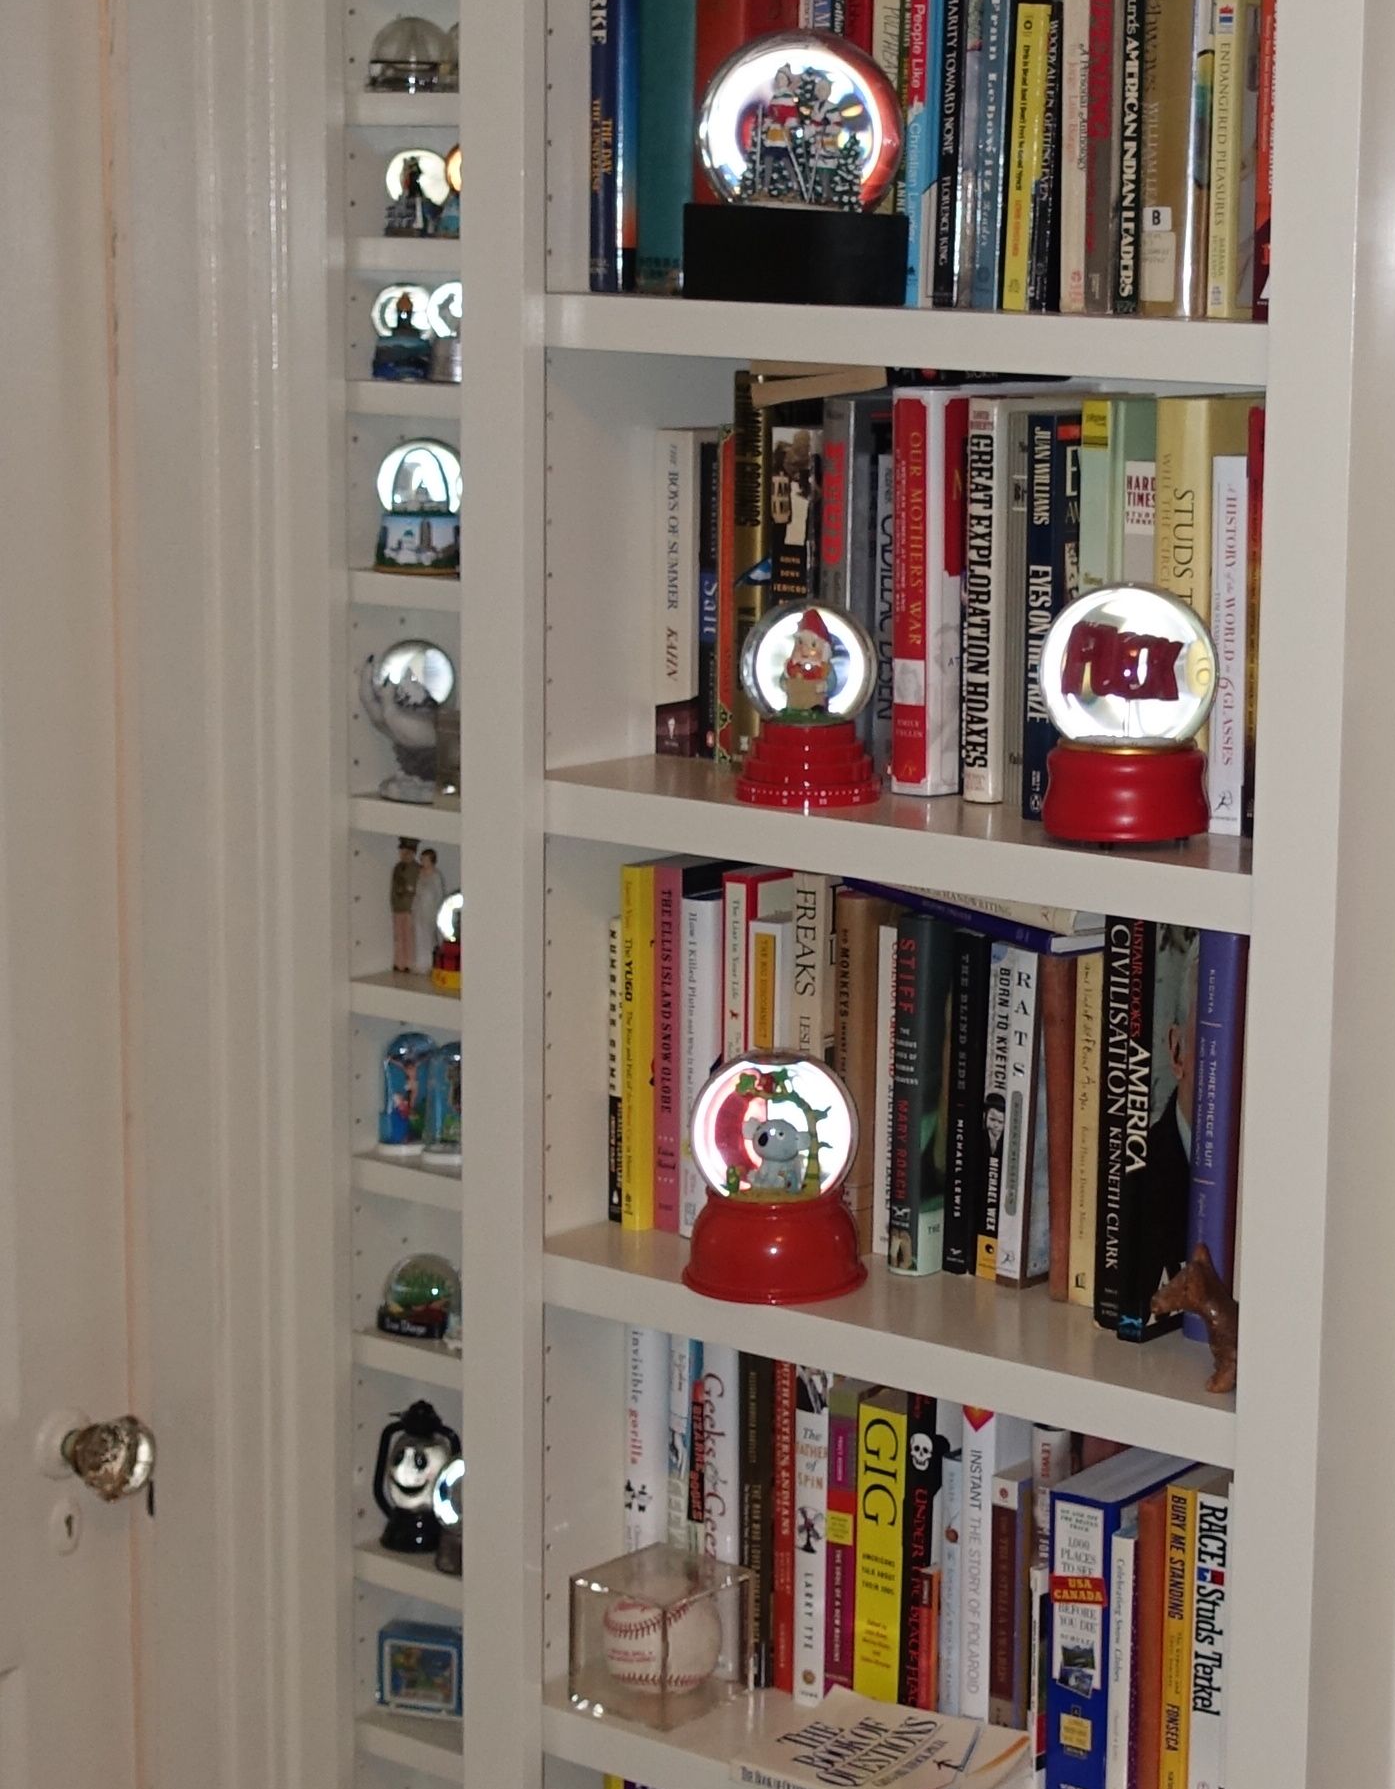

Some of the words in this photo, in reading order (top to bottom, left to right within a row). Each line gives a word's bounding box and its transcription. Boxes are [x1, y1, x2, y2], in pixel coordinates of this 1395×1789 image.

[911, 57, 924, 89] Like
[1126, 39, 1140, 131] AMERICAN
[1217, 42, 1231, 137] ENDANGERED
[1123, 130, 1139, 197] INDIAN
[1214, 142, 1230, 226] PLEASURES
[1120, 202, 1136, 298] LEADERS
[910, 431, 921, 471] OUR
[971, 434, 993, 510] GREAT
[667, 471, 680, 511] BOYS
[909, 481, 923, 592] MOTHERS'
[1173, 488, 1194, 578] STUDS
[667, 541, 679, 609] SUMMER
[703, 579, 718, 635] Salt
[966, 513, 993, 676] EXPLORATION
[908, 599, 921, 644] WAR
[665, 629, 679, 680] KAHN
[964, 683, 989, 768] HOAXES
[796, 888, 817, 997] FREAKS
[898, 938, 915, 1014] STIFF
[999, 967, 1011, 1011] BORN
[999, 1016, 1008, 1030] TO
[1107, 924, 1131, 1116] CIVILISATION
[995, 1033, 1008, 1094] KVETCH
[1125, 1038, 1152, 1173] AMERICA
[1107, 1125, 1122, 1203] KENNETH
[1103, 1212, 1119, 1270] CLARK
[863, 1418, 898, 1529] GIG
[968, 1449, 983, 1511] INSTANT
[968, 1517, 983, 1545] THE
[1172, 1534, 1184, 1553] ME
[1174, 1494, 1187, 1531] BURY
[1198, 1502, 1227, 1573] RACE
[968, 1549, 983, 1598] STORY
[1054, 1589, 1103, 1602] CANADA
[1067, 1577, 1092, 1590] USA
[1169, 1556, 1184, 1620] STANDING
[1199, 1584, 1225, 1645] Studs
[968, 1618, 983, 1693] POLAROID
[1193, 1644, 1223, 1716] Terkel
[1165, 1704, 1180, 1753] FONSECA
